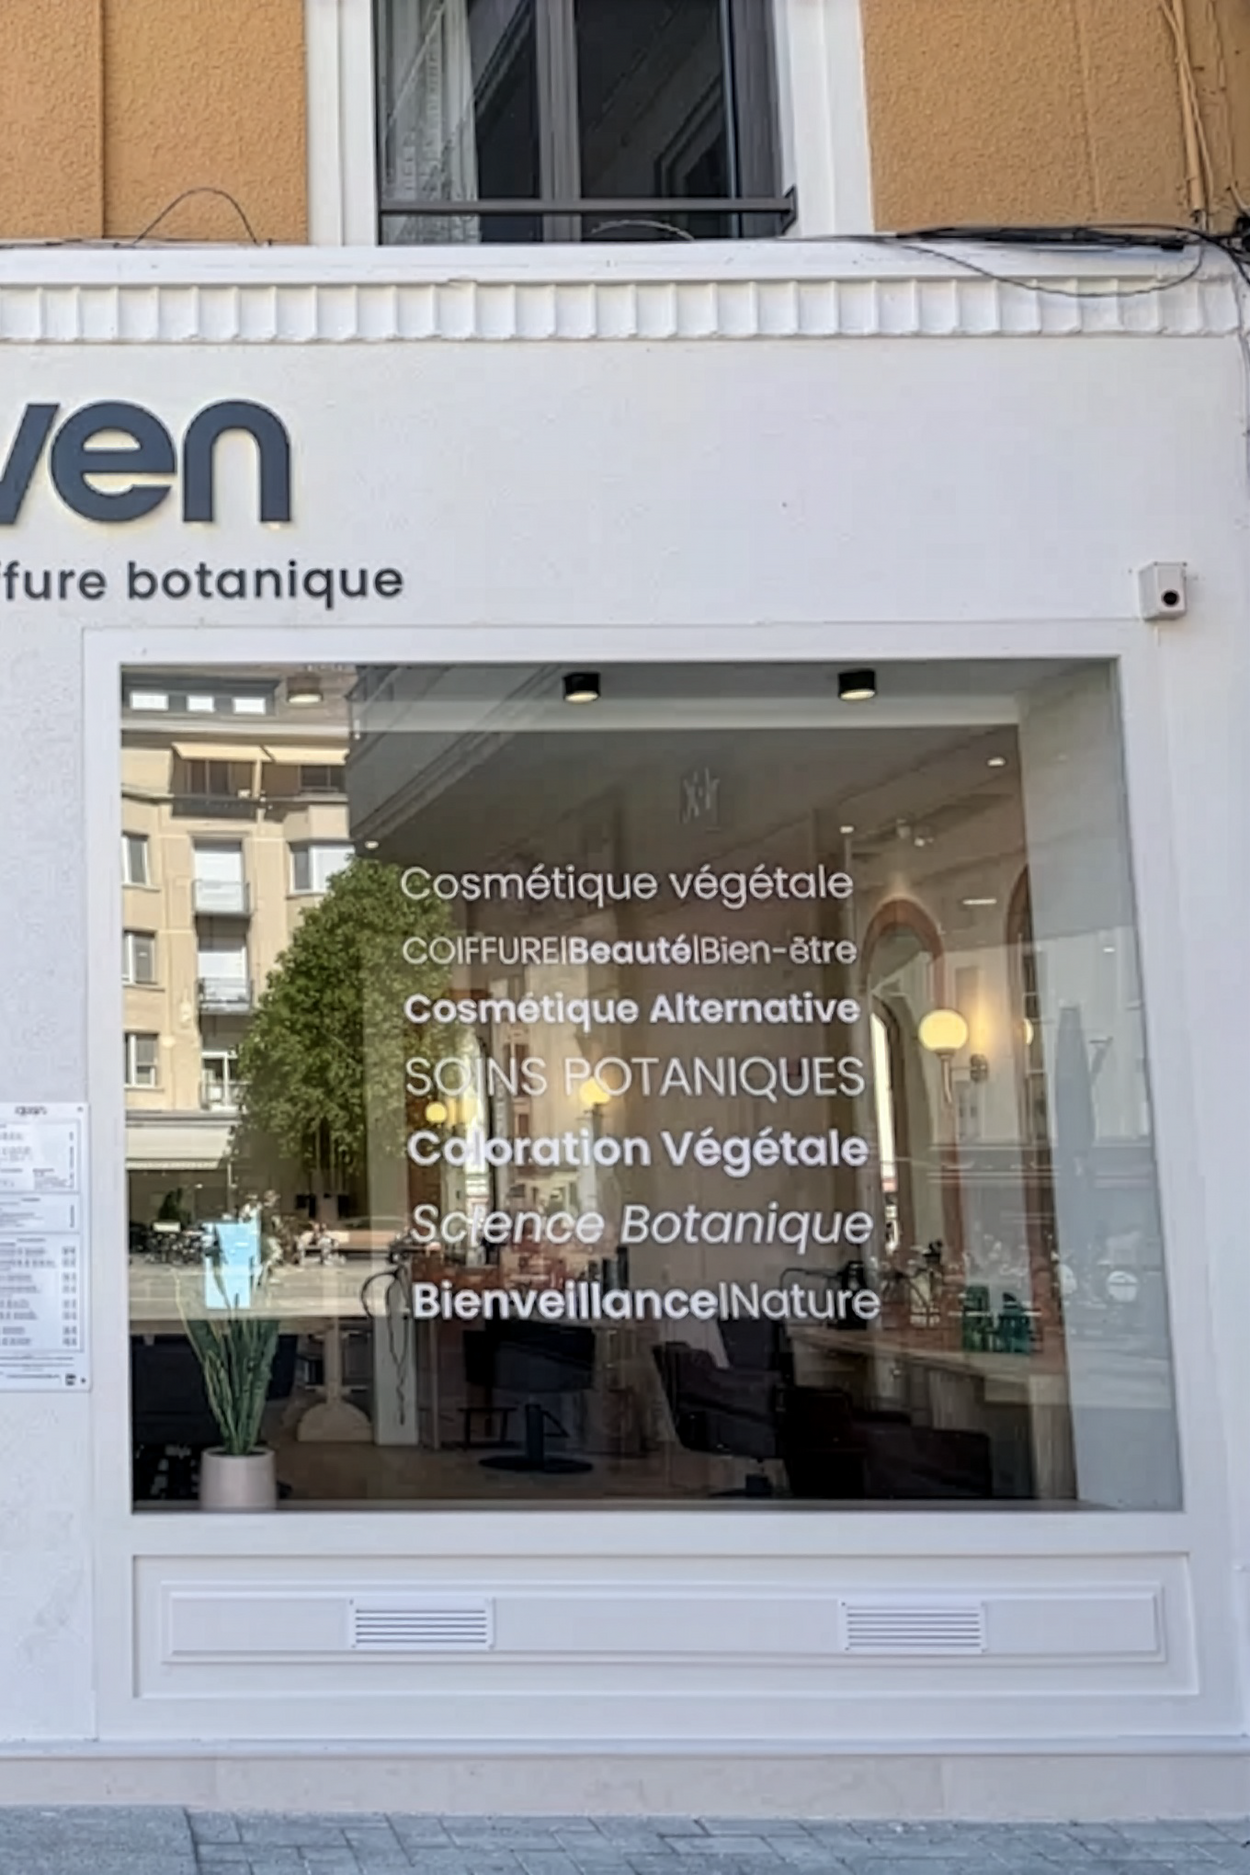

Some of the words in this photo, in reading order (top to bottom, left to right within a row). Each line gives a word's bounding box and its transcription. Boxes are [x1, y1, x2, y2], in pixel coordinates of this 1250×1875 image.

[127, 559, 404, 611] botanique
[400, 864, 658, 909] Cosmétique
[670, 864, 854, 910] végétale
[404, 992, 639, 1033] Cosmétique
[649, 991, 862, 1025] Alternative
[405, 1056, 547, 1098] SOINS
[407, 1128, 651, 1168] Coloration
[661, 1127, 870, 1179] Végétale
[410, 1203, 605, 1244] Science
[621, 1201, 874, 1254] Botanique
